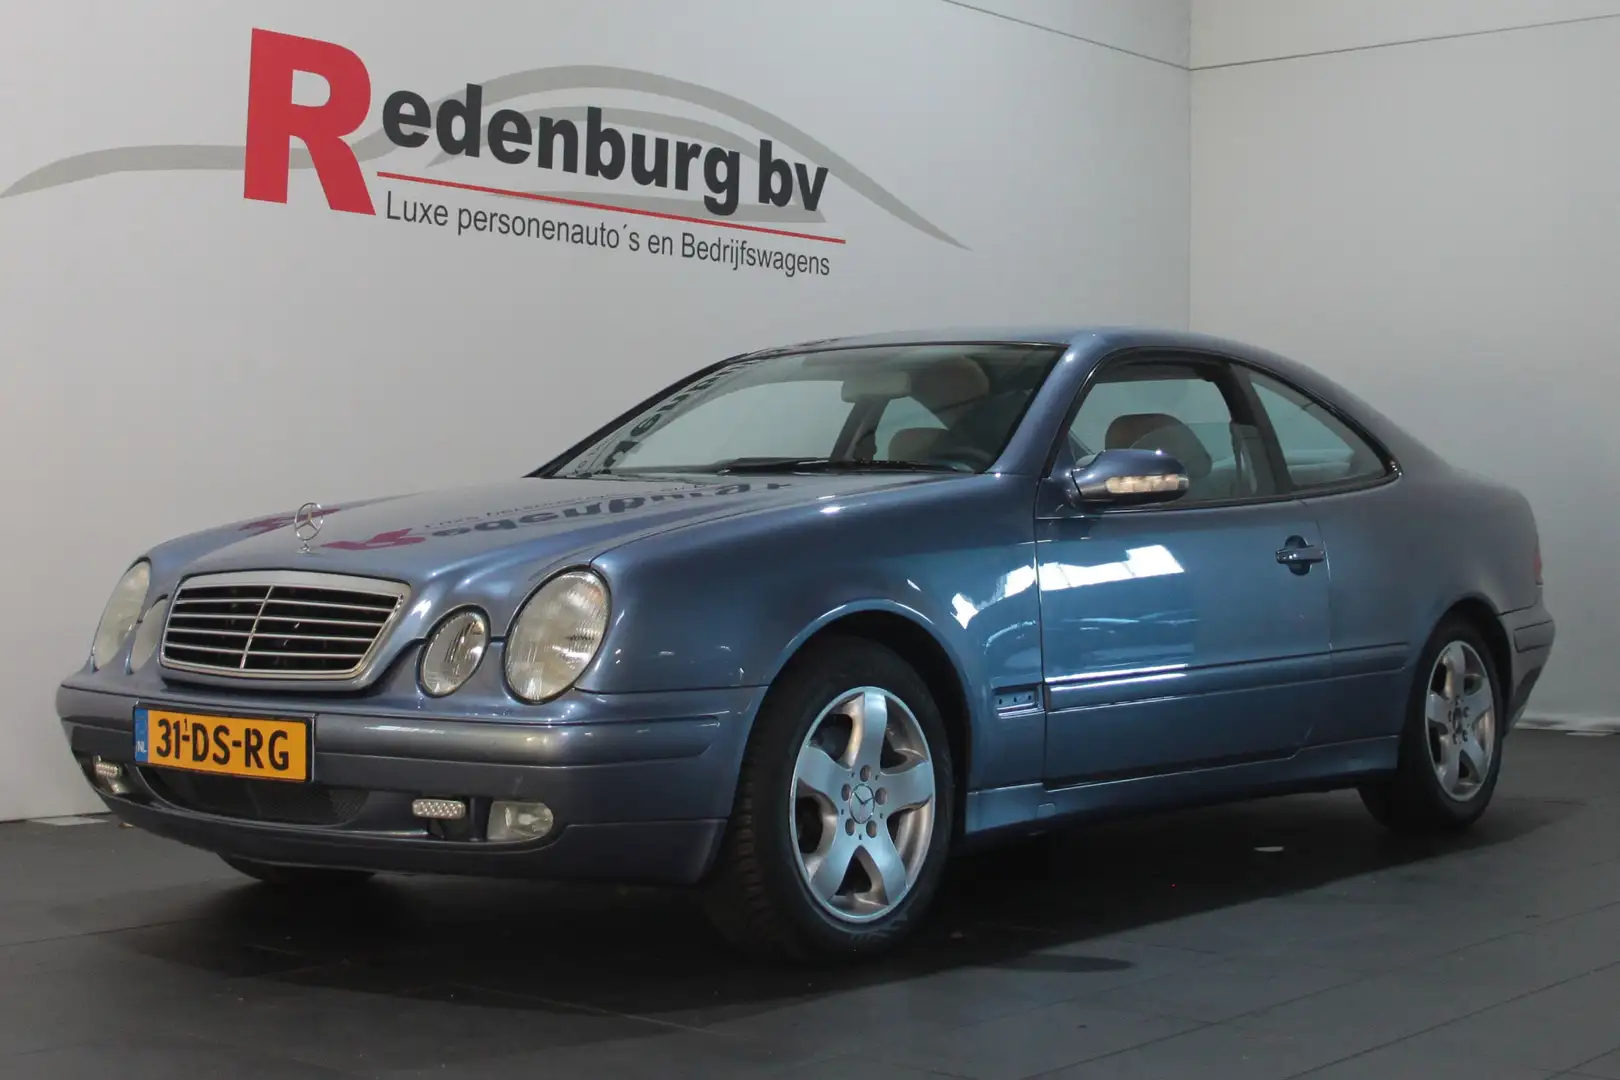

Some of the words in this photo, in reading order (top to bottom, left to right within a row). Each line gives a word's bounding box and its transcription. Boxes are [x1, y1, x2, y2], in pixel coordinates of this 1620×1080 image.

[244, 28, 739, 218] Redenburg
[757, 139, 829, 212] bv
[386, 190, 448, 226] Luxe
[647, 233, 673, 256] en
[681, 232, 830, 278] Bedrijfswagens
[136, 740, 147, 753] NL
[156, 718, 290, 771] 31-DS-RG
